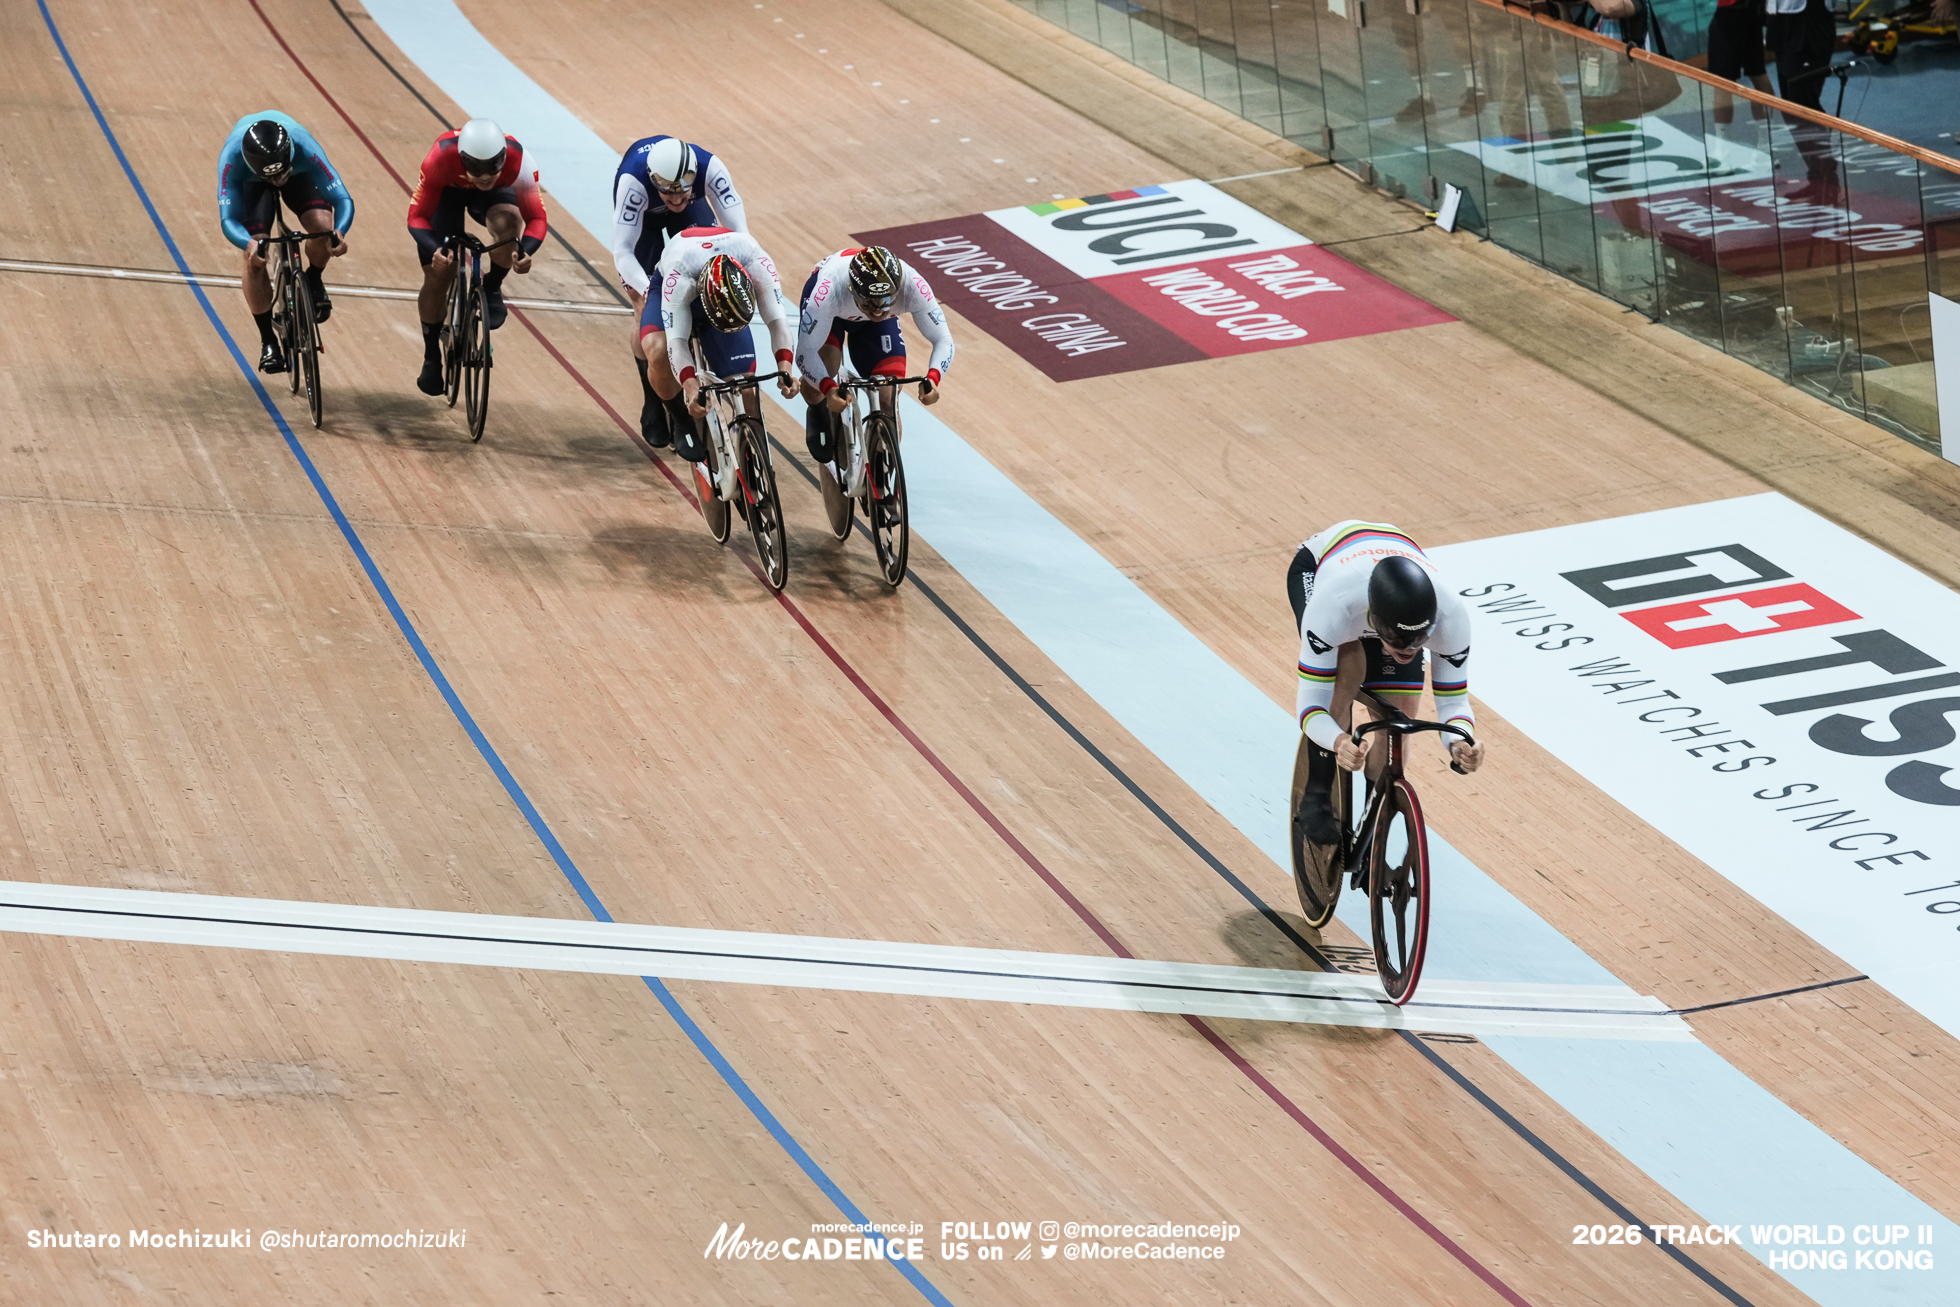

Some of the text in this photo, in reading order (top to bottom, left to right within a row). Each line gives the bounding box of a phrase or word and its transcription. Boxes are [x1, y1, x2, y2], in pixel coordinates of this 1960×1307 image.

[326, 179, 342, 192] HKG
[621, 192, 643, 223] CIC
[714, 176, 736, 206] CIC
[1050, 195, 1260, 267] UCI
[905, 234, 1006, 276] HONG
[956, 260, 1059, 313] KONG
[1021, 312, 1128, 359] CHINA
[1140, 266, 1310, 343] WORLD CUP
[1226, 252, 1347, 301] TRACK
[1459, 582, 1595, 652] SWISS
[1567, 655, 1778, 774] WATCHES
[1752, 782, 1932, 873] SINCE
